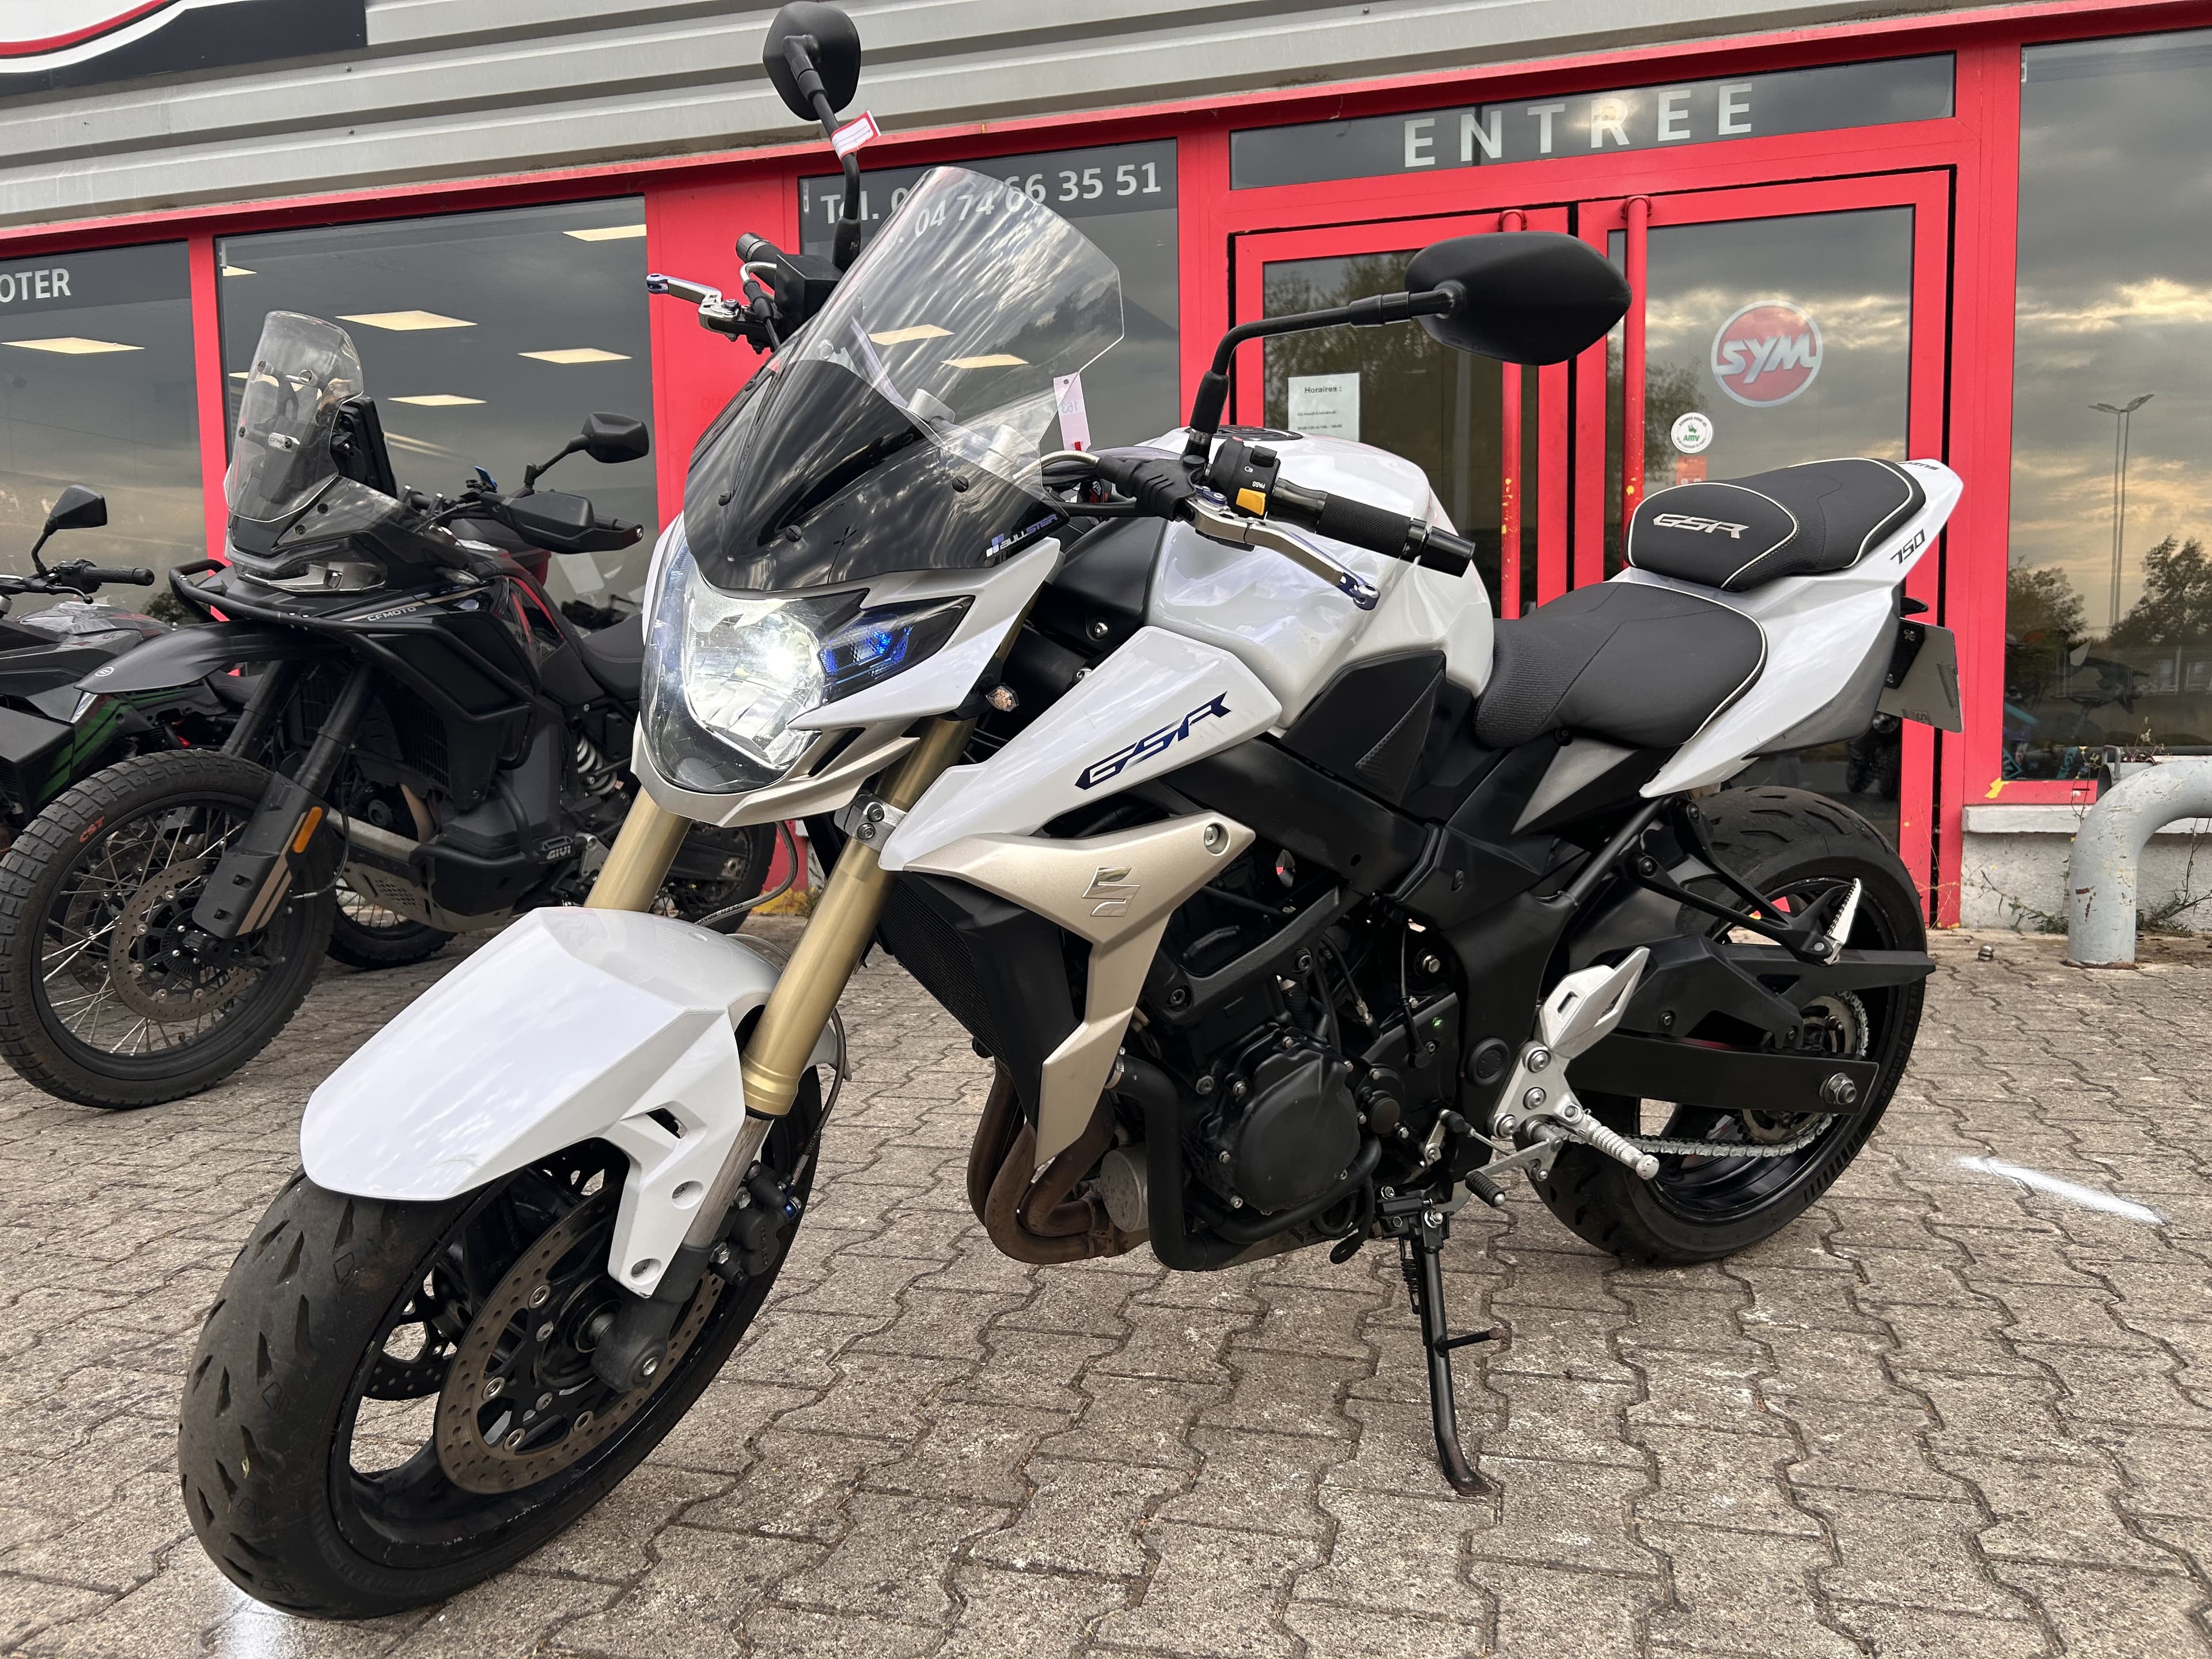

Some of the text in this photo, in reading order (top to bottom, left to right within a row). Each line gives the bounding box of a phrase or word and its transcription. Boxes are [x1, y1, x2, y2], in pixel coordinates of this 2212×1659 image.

[1404, 82, 1752, 168] ENTREE
[1058, 168, 1103, 202] 35
[1115, 162, 1161, 196] 51
[1714, 333, 1816, 385] SYM
[1252, 480, 1266, 489] PASS
[999, 513, 1058, 550] BULLSTER
[1653, 513, 1750, 539] GSR
[1889, 528, 1925, 565] 750
[367, 607, 416, 622] CFMOTO
[1074, 691, 1232, 790] GSR
[79, 816, 105, 843] CST
[547, 845, 571, 859] GIVI
